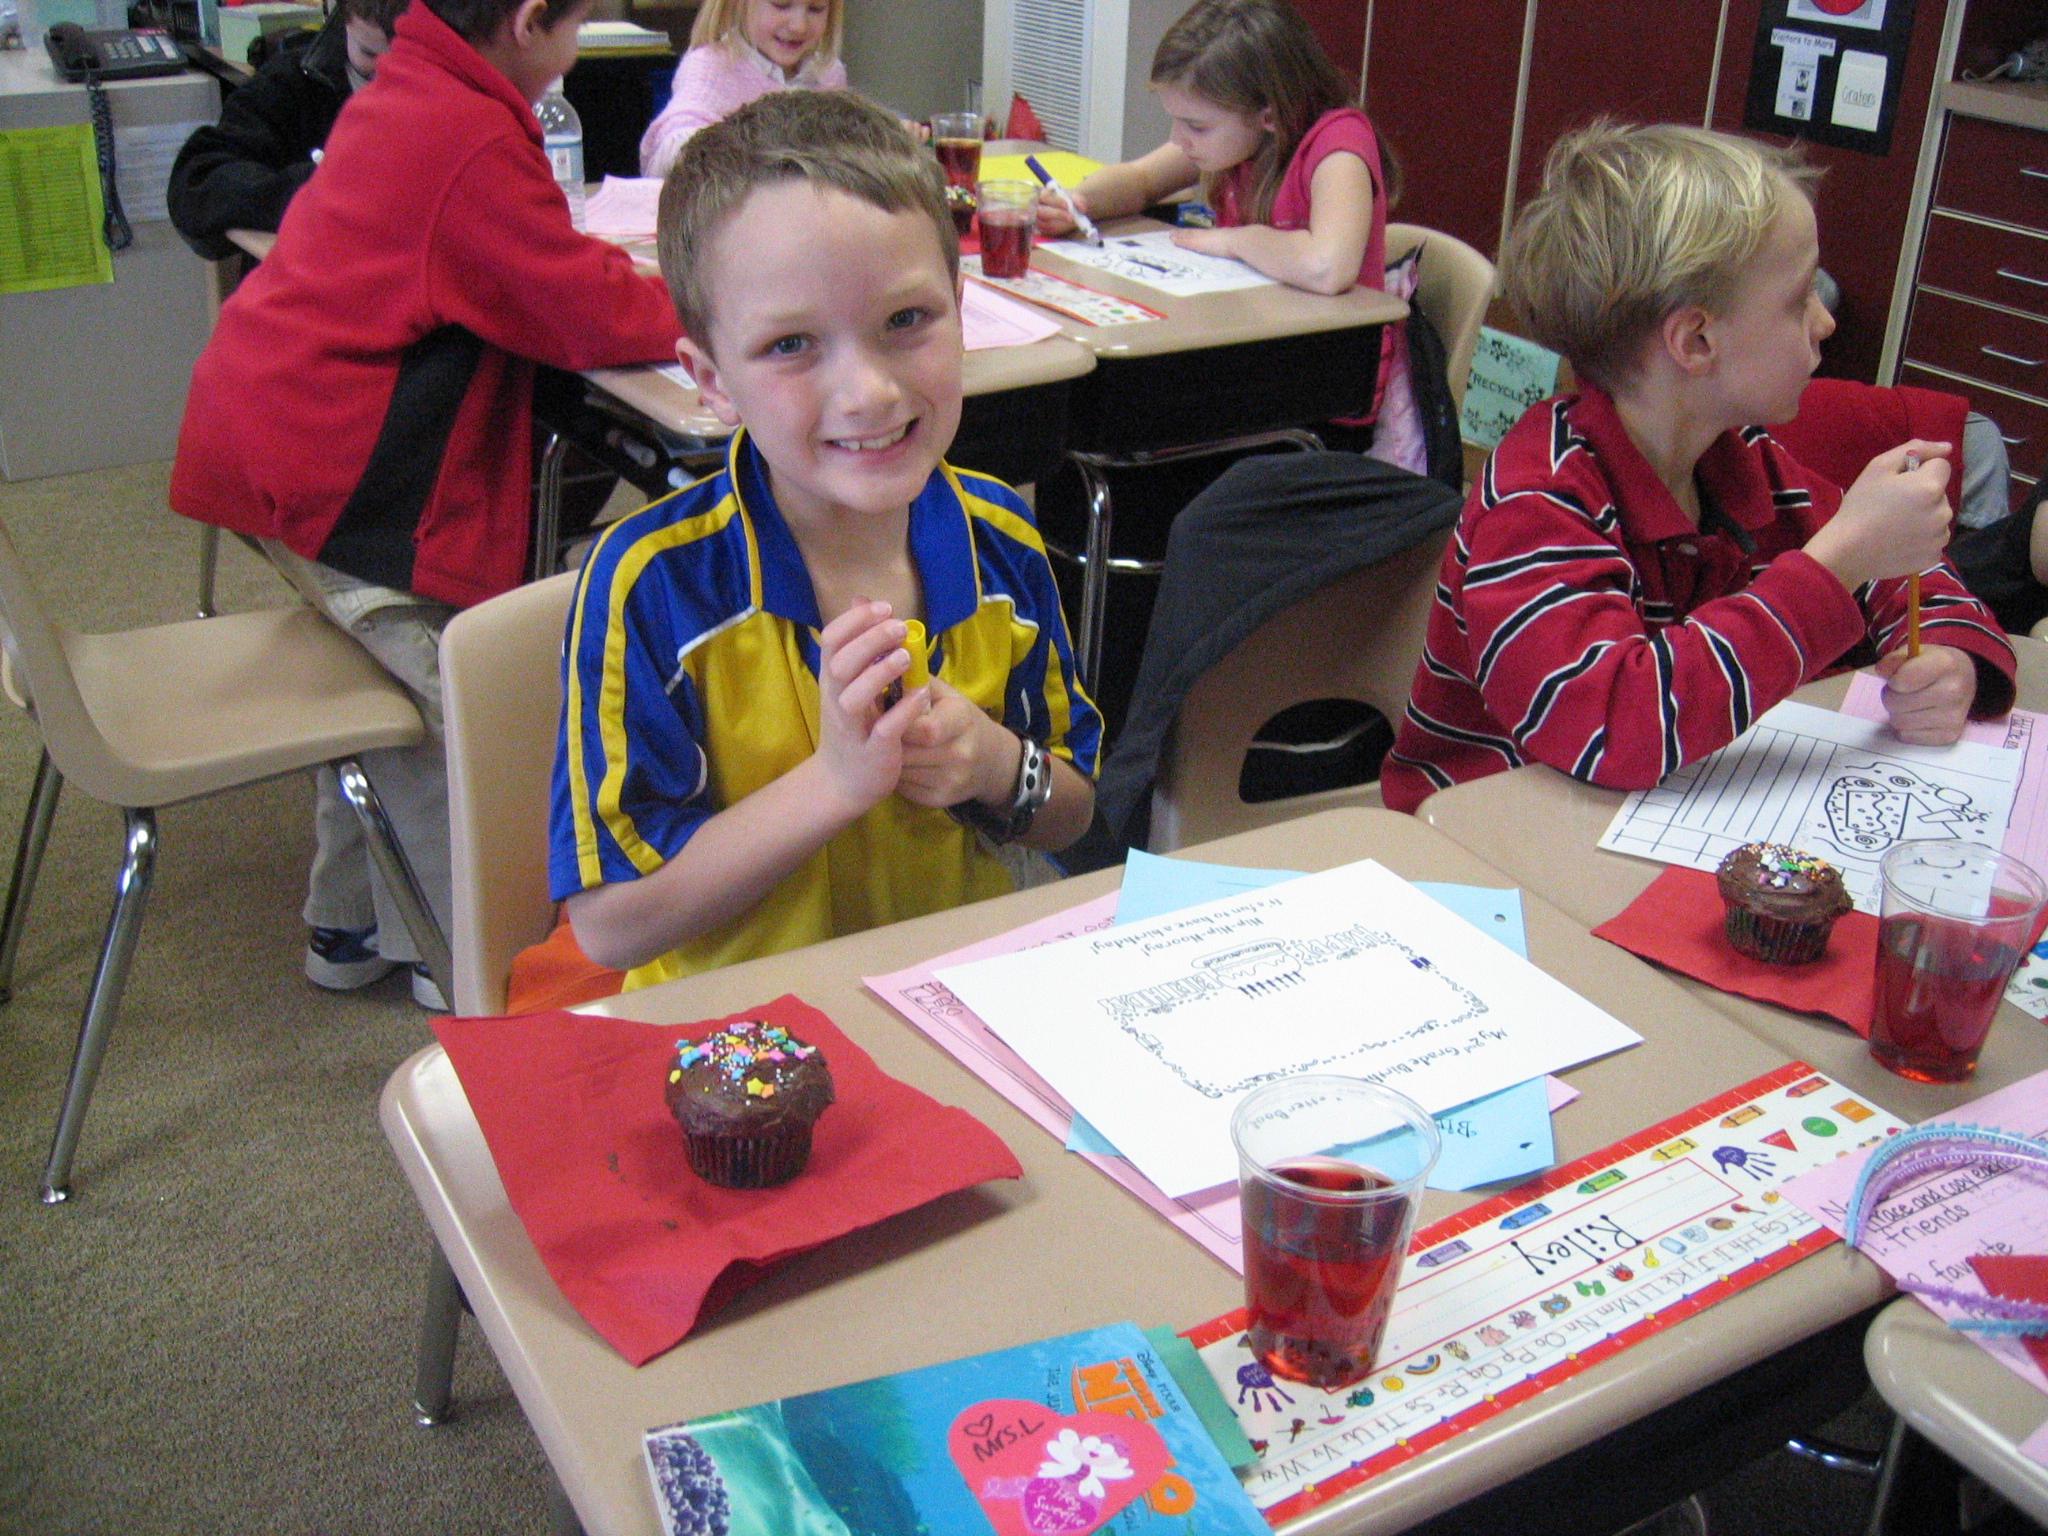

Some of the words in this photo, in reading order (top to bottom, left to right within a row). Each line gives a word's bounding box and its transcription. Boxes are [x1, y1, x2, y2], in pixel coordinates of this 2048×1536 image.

[1214, 909, 1229, 919] to
[1232, 902, 1259, 915] fun
[1176, 915, 1215, 929] have
[1090, 928, 1165, 955] birthday!
[1295, 924, 1381, 962] HAPPY
[1097, 971, 1224, 1016] BIRTHDAY
[1478, 1027, 1508, 1042] My
[1410, 1046, 1461, 1067] Grade
[1911, 1185, 1944, 1210] and
[1751, 1220, 1790, 1235] Gg
[1881, 1203, 1971, 1250] friends
[1510, 1214, 1643, 1276] Riley
[1929, 1238, 2014, 1284] favite
[1596, 1292, 1641, 1315] Mm
[1564, 1314, 1602, 1333] Nn
[1156, 1382, 1182, 1414] PIXAR
[1438, 1379, 1469, 1398] Rr
[1077, 1360, 1197, 1517] NEO
